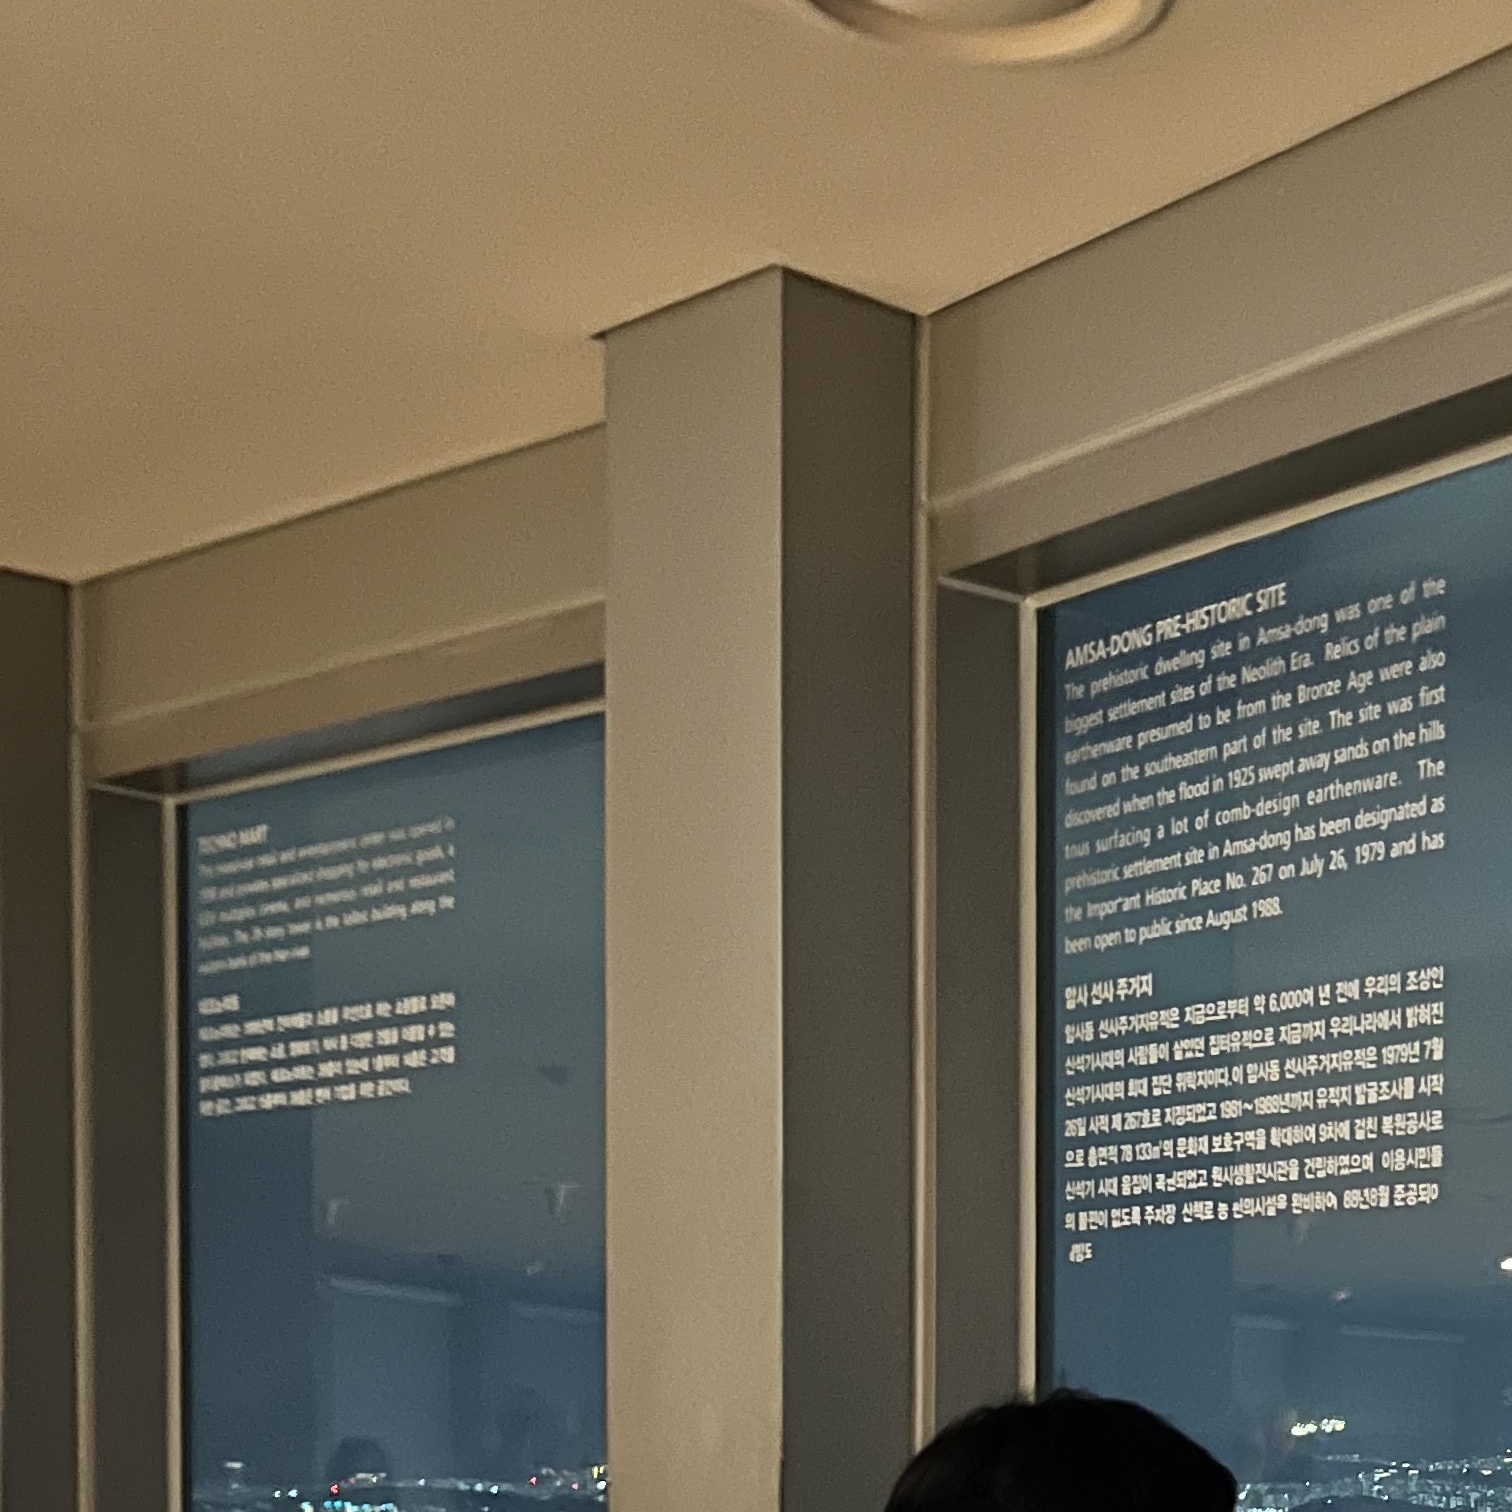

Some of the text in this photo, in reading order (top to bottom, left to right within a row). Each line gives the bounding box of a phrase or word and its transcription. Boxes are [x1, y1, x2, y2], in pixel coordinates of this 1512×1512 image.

[1065, 582, 1286, 670] AMSA-DONG PRE-HISTORIC SITE
[1065, 577, 1446, 700] The prehistoric dwelling site in Amsa-dong was one of the
[1065, 709, 1103, 735] biggest
[1108, 691, 1166, 721] settlement
[1170, 683, 1194, 704] sites
[1200, 673, 1212, 696] of
[1217, 671, 1236, 691] the
[1290, 651, 1314, 672] Era.
[1325, 637, 1360, 661] Relics
[1364, 627, 1379, 650] of
[1385, 623, 1407, 645] the
[1412, 611, 1446, 643] plain
[1065, 649, 1446, 765] earthenware presumed to be from the Bronze Age were also
[1065, 684, 1446, 795] found on the southeastern part of the site. The site was first
[1065, 719, 1446, 828] discovered when the flood in 1925 swept away sands on the hills
[1065, 794, 1445, 895] prehistoric settlement site in Amsa-dong has been designated as
[1096, 826, 1151, 854] surfacing
[1157, 824, 1165, 839] a
[1171, 816, 1188, 836] lot
[1195, 808, 1209, 831] of
[1215, 791, 1299, 826] comb-design
[1307, 771, 1402, 806] earthenware.
[1418, 758, 1445, 780] The
[1065, 904, 1083, 923] the
[1145, 881, 1187, 906] Historic
[1191, 877, 1221, 897] Place
[1225, 871, 1247, 890] No.
[1251, 863, 1274, 886] 267
[1278, 863, 1296, 880] on
[1300, 852, 1325, 878] July
[1329, 848, 1348, 871] 26,
[1355, 840, 1386, 865] 1979
[1390, 832, 1416, 858] and
[1421, 830, 1445, 851] has
[1065, 936, 1091, 954] been
[1093, 930, 1122, 952] open
[1124, 927, 1136, 943] to
[1139, 916, 1172, 945] public
[1175, 912, 1203, 934] since
[1206, 903, 1248, 930] August
[1065, 972, 1153, 1010] 암사 선사 주거지
[1065, 1020, 1094, 1044] 암사동
[1184, 996, 1249, 1025] 지금으로부터
[1253, 994, 1266, 1014] 약
[1319, 983, 1331, 1006] 년
[1364, 972, 1401, 998] 우리의
[1279, 1019, 1325, 1045] 지금까지
[1330, 1007, 1401, 1038] 우리나라에서
[1247, 1059, 1280, 1084] 암사동
[1284, 1046, 1377, 1079] 선사주거지유적은
[1382, 1039, 1420, 1065] 1979년
[1316, 1085, 1352, 1109] 유적지
[1418, 1073, 1444, 1096] 시작
[1064, 1149, 1085, 1168] 으로
